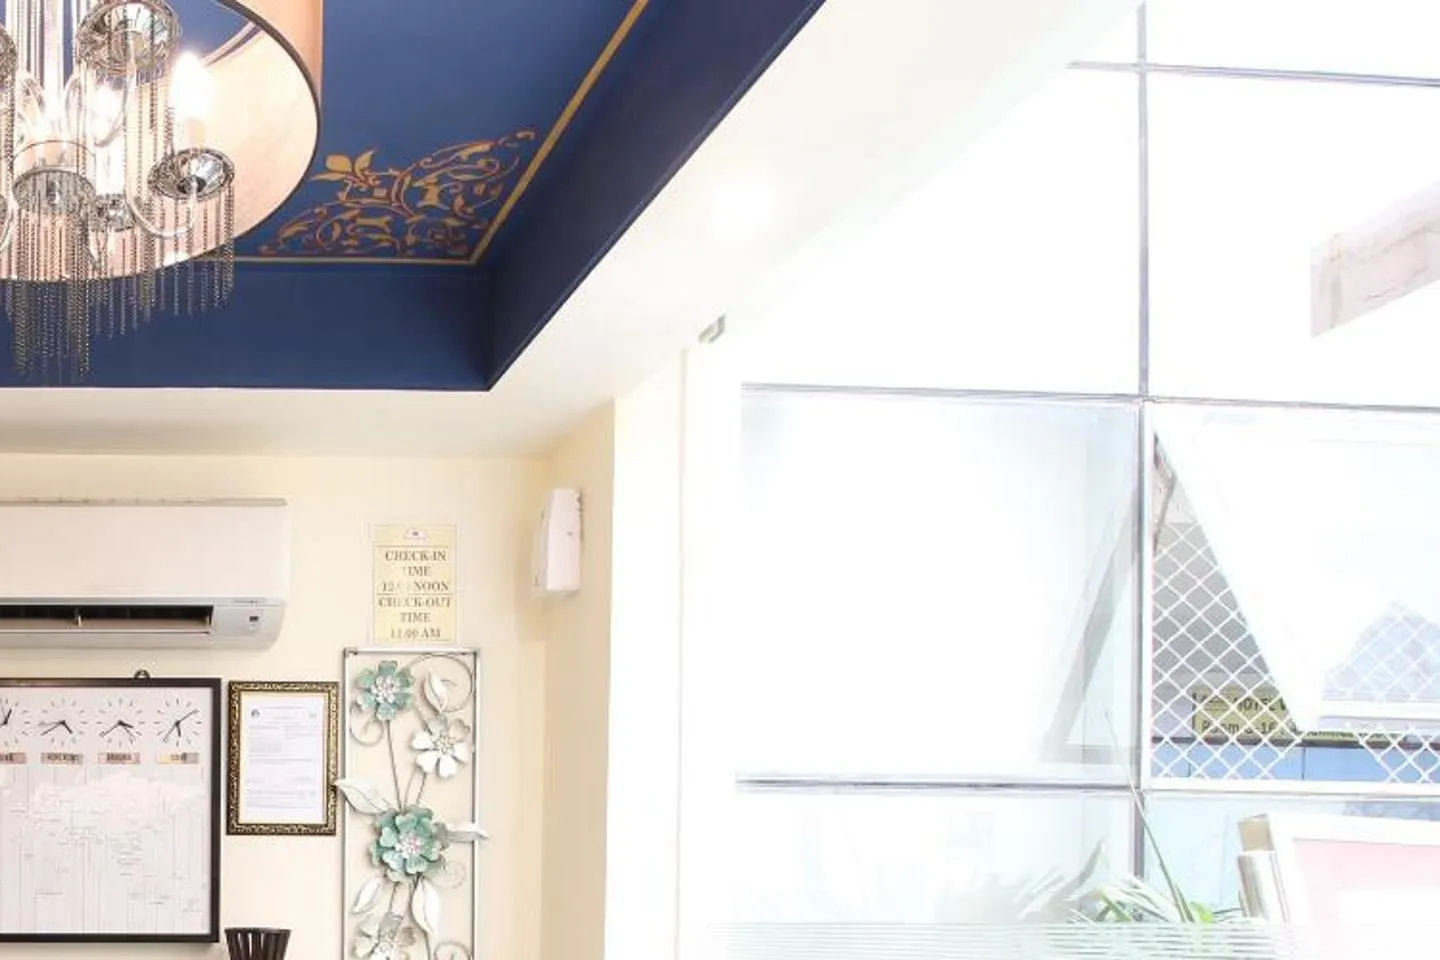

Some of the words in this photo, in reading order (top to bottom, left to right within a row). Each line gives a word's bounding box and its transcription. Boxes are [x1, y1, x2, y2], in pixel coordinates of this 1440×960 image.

[412, 581, 449, 592] NOON
[399, 612, 431, 623] TIME
[421, 627, 441, 638] AM
